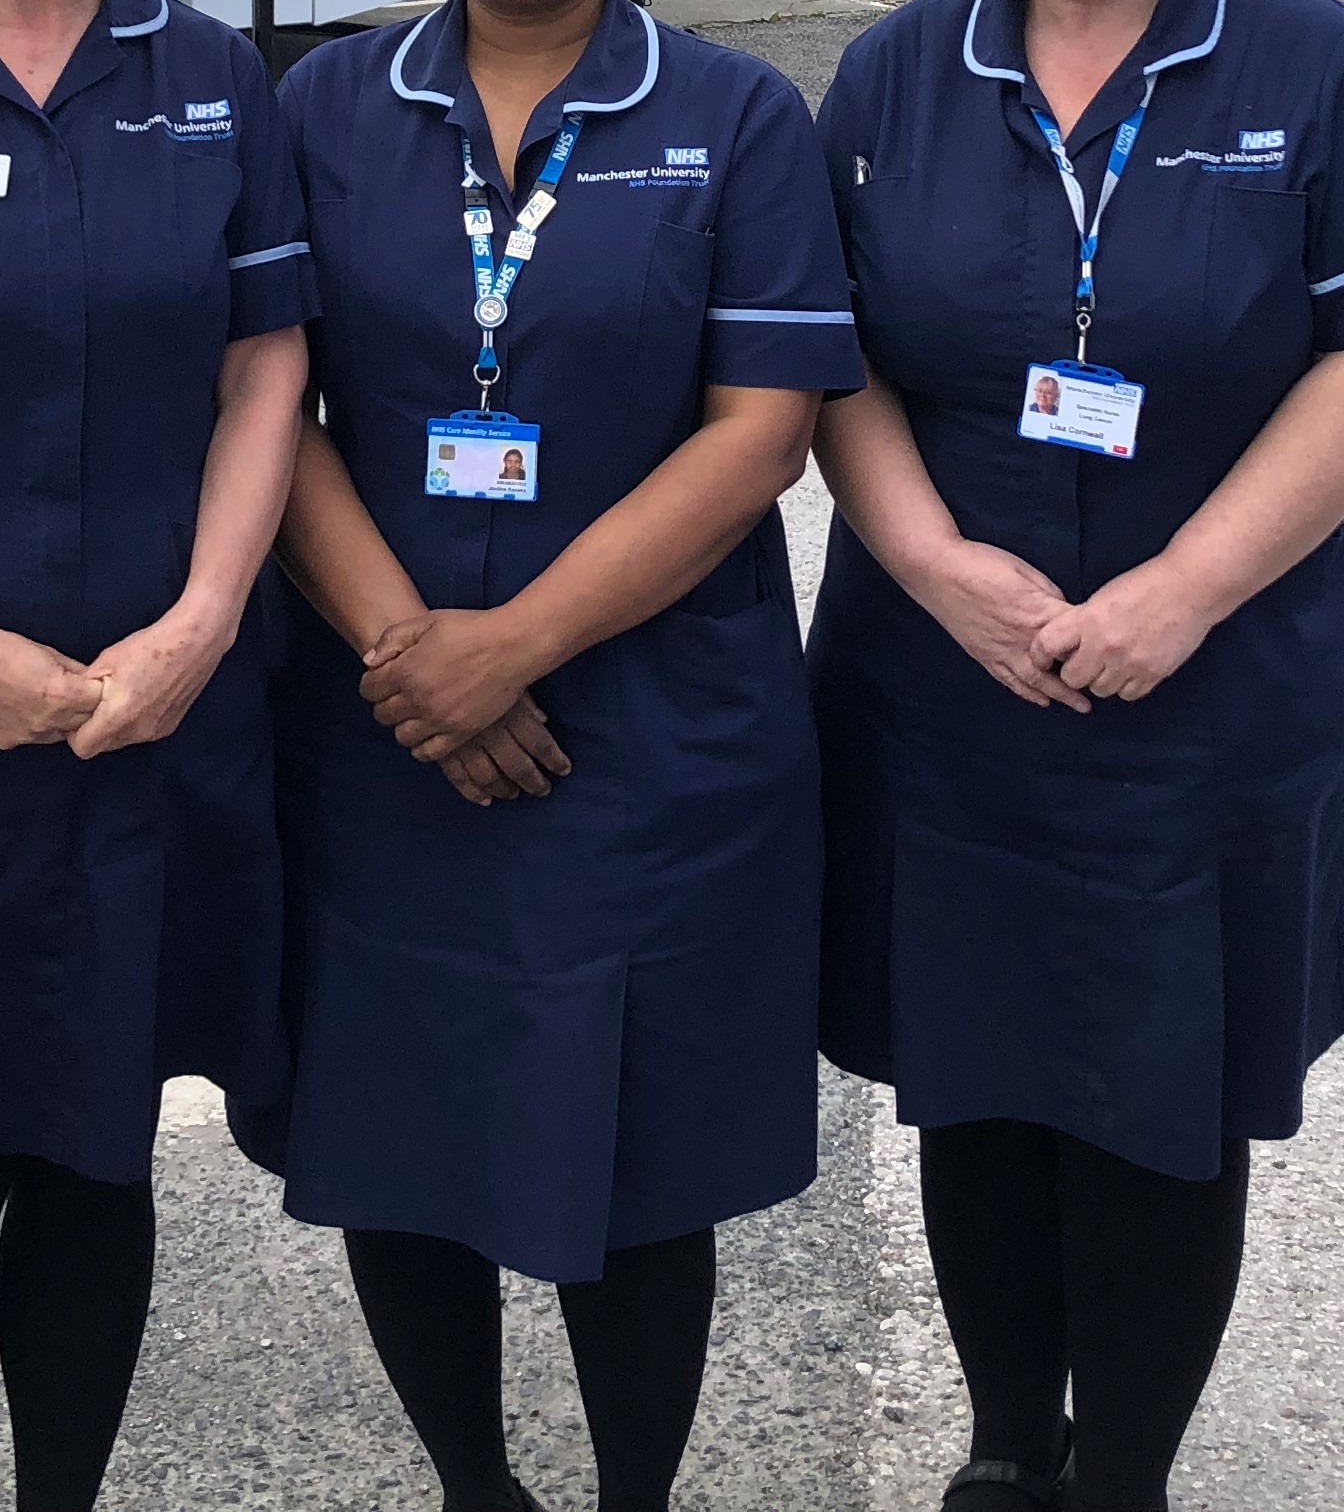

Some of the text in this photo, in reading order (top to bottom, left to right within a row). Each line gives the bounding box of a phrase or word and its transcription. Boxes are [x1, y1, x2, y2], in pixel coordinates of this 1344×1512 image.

[187, 100, 227, 120] NHS
[173, 119, 232, 133] University
[552, 131, 574, 161] NHS
[1116, 125, 1134, 154] NHS
[1240, 129, 1285, 148] NHS
[667, 148, 706, 164] NHS
[1224, 150, 1286, 163] University
[577, 167, 710, 182] Manchester University
[466, 211, 488, 225] 70
[523, 199, 543, 219] 75
[492, 264, 516, 299] NHS
[462, 428, 487, 436] Identity
[488, 429, 511, 437] Service
[1050, 422, 1104, 440] Lisa Cornwall
